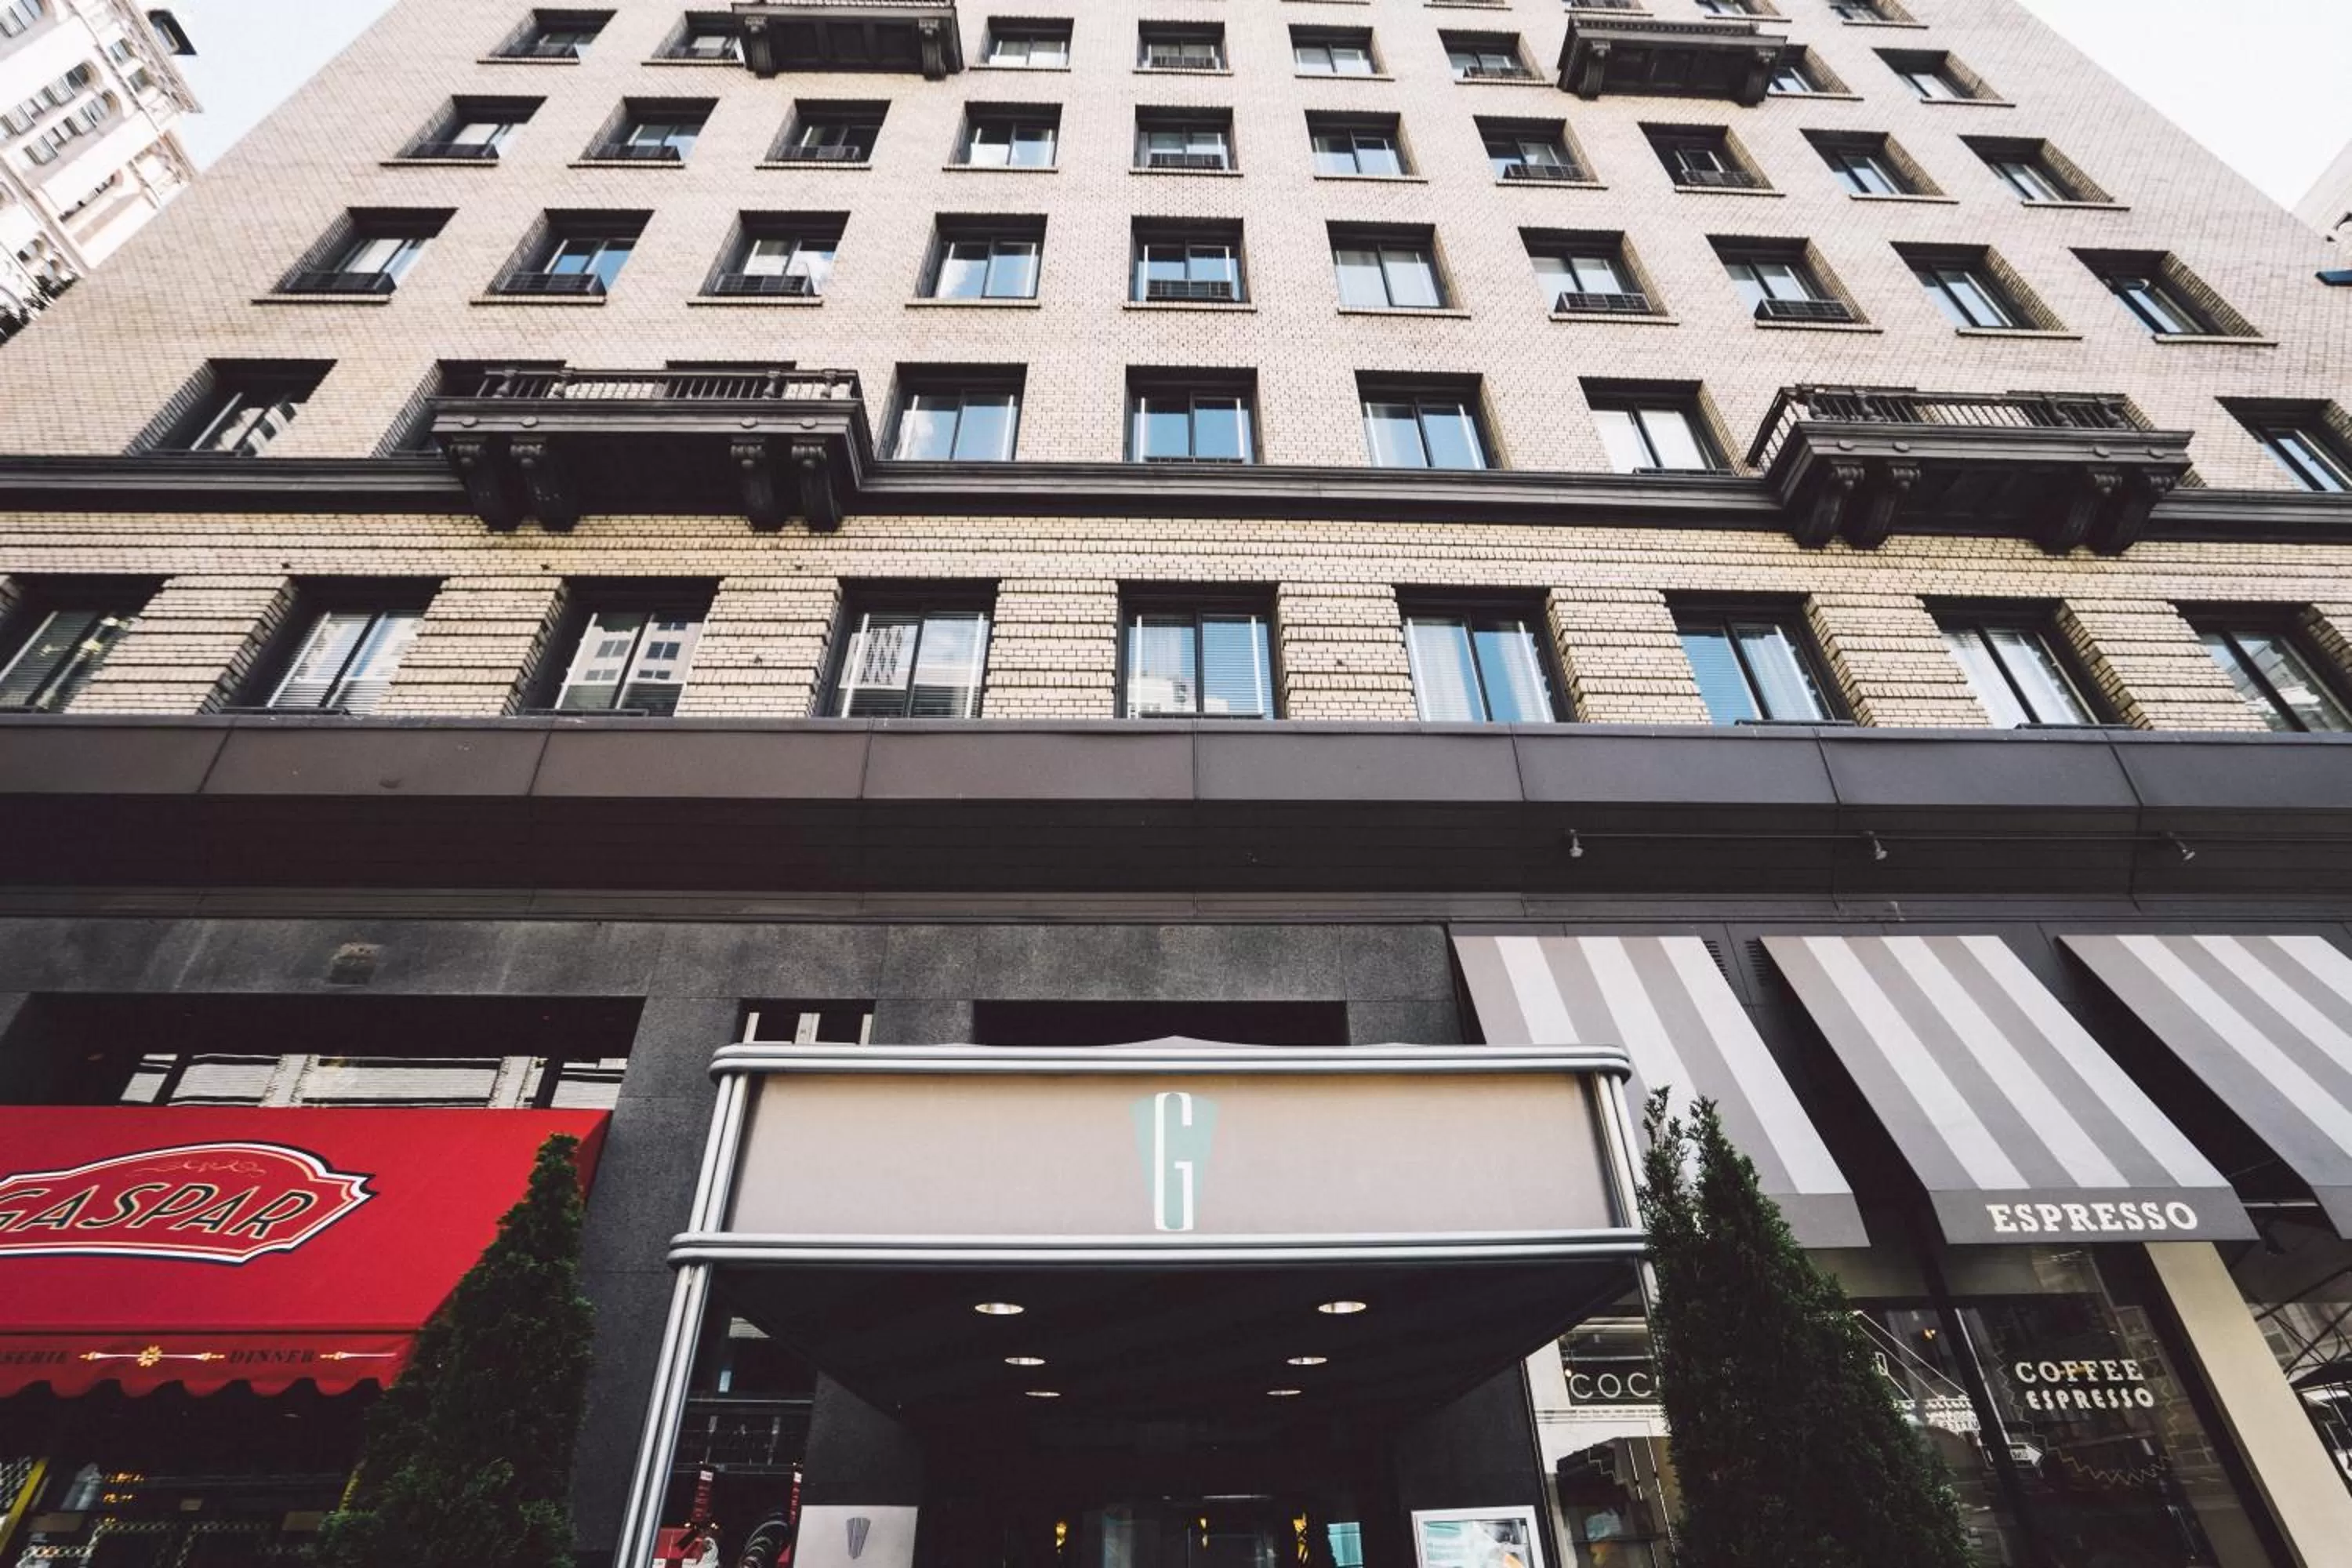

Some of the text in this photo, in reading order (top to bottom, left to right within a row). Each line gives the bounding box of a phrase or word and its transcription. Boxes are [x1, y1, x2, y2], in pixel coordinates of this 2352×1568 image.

[1155, 1092, 1193, 1231] G
[0, 1182, 319, 1240] GASPAR
[1985, 1201, 2198, 1232] ESPRESSO
[228, 1349, 314, 1367] DINNER
[2015, 1359, 2144, 1383] COFFEE
[1570, 1372, 1660, 1399] COC
[2026, 1387, 2154, 1410] ESPRESSO
